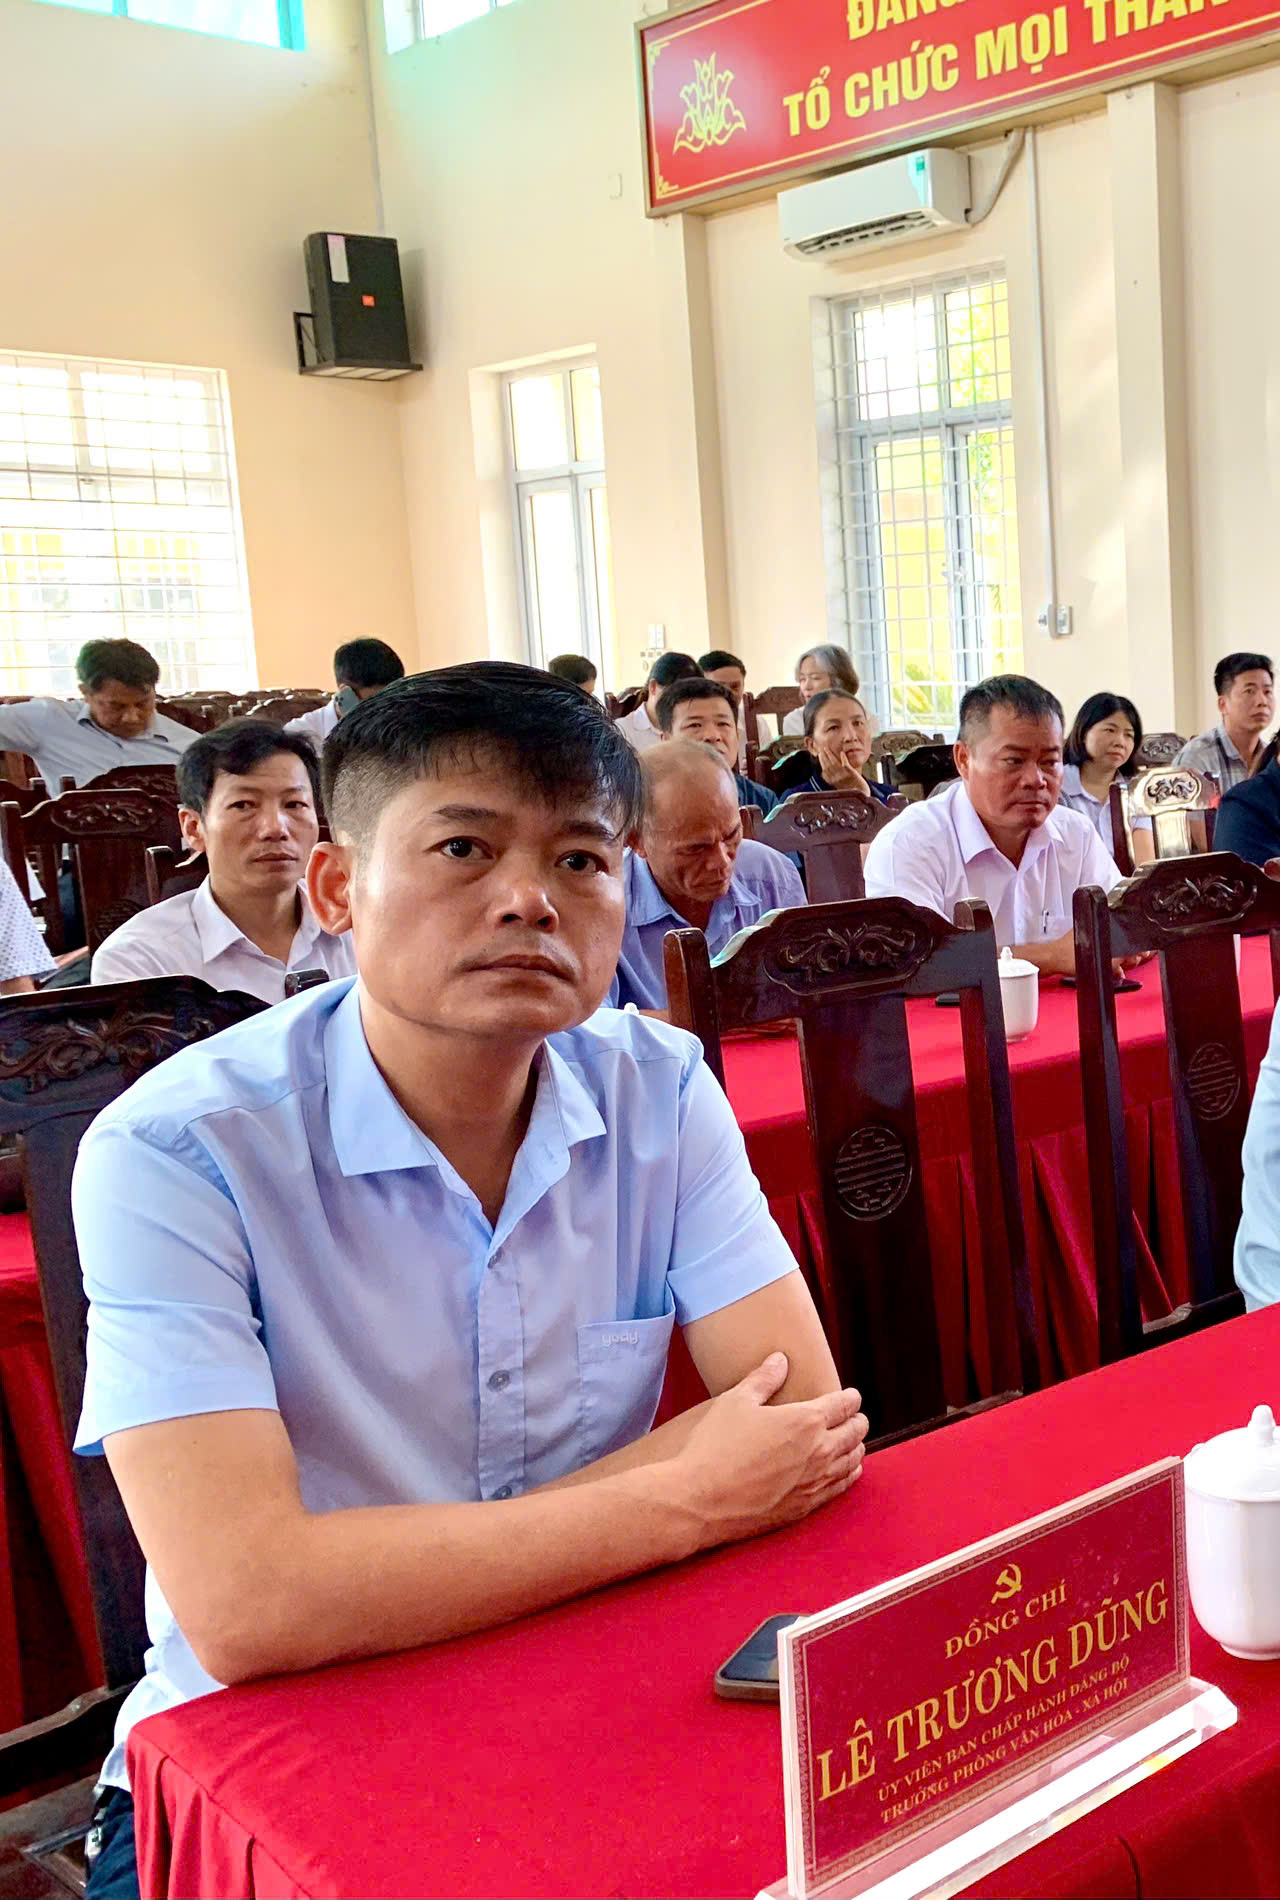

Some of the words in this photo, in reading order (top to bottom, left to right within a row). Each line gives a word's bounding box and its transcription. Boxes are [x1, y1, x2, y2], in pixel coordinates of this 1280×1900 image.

[783, 65, 831, 137] TỔ
[844, 39, 959, 118] CHỨC
[975, 5, 1068, 80] MỌI
[944, 1608, 1020, 1660] ĐỒNG
[1024, 1578, 1068, 1619] CHÍ
[816, 1717, 877, 1801] LÊ
[887, 1635, 1059, 1764] TRƯƠNG
[1068, 1578, 1169, 1670] DŨNG
[903, 1755, 944, 1786] VIÊN
[945, 1735, 978, 1766] BAN
[1025, 1685, 1067, 1722] HÀNH
[953, 1742, 1007, 1785] PHÒNG
[1103, 1676, 1129, 1700] HỘI
